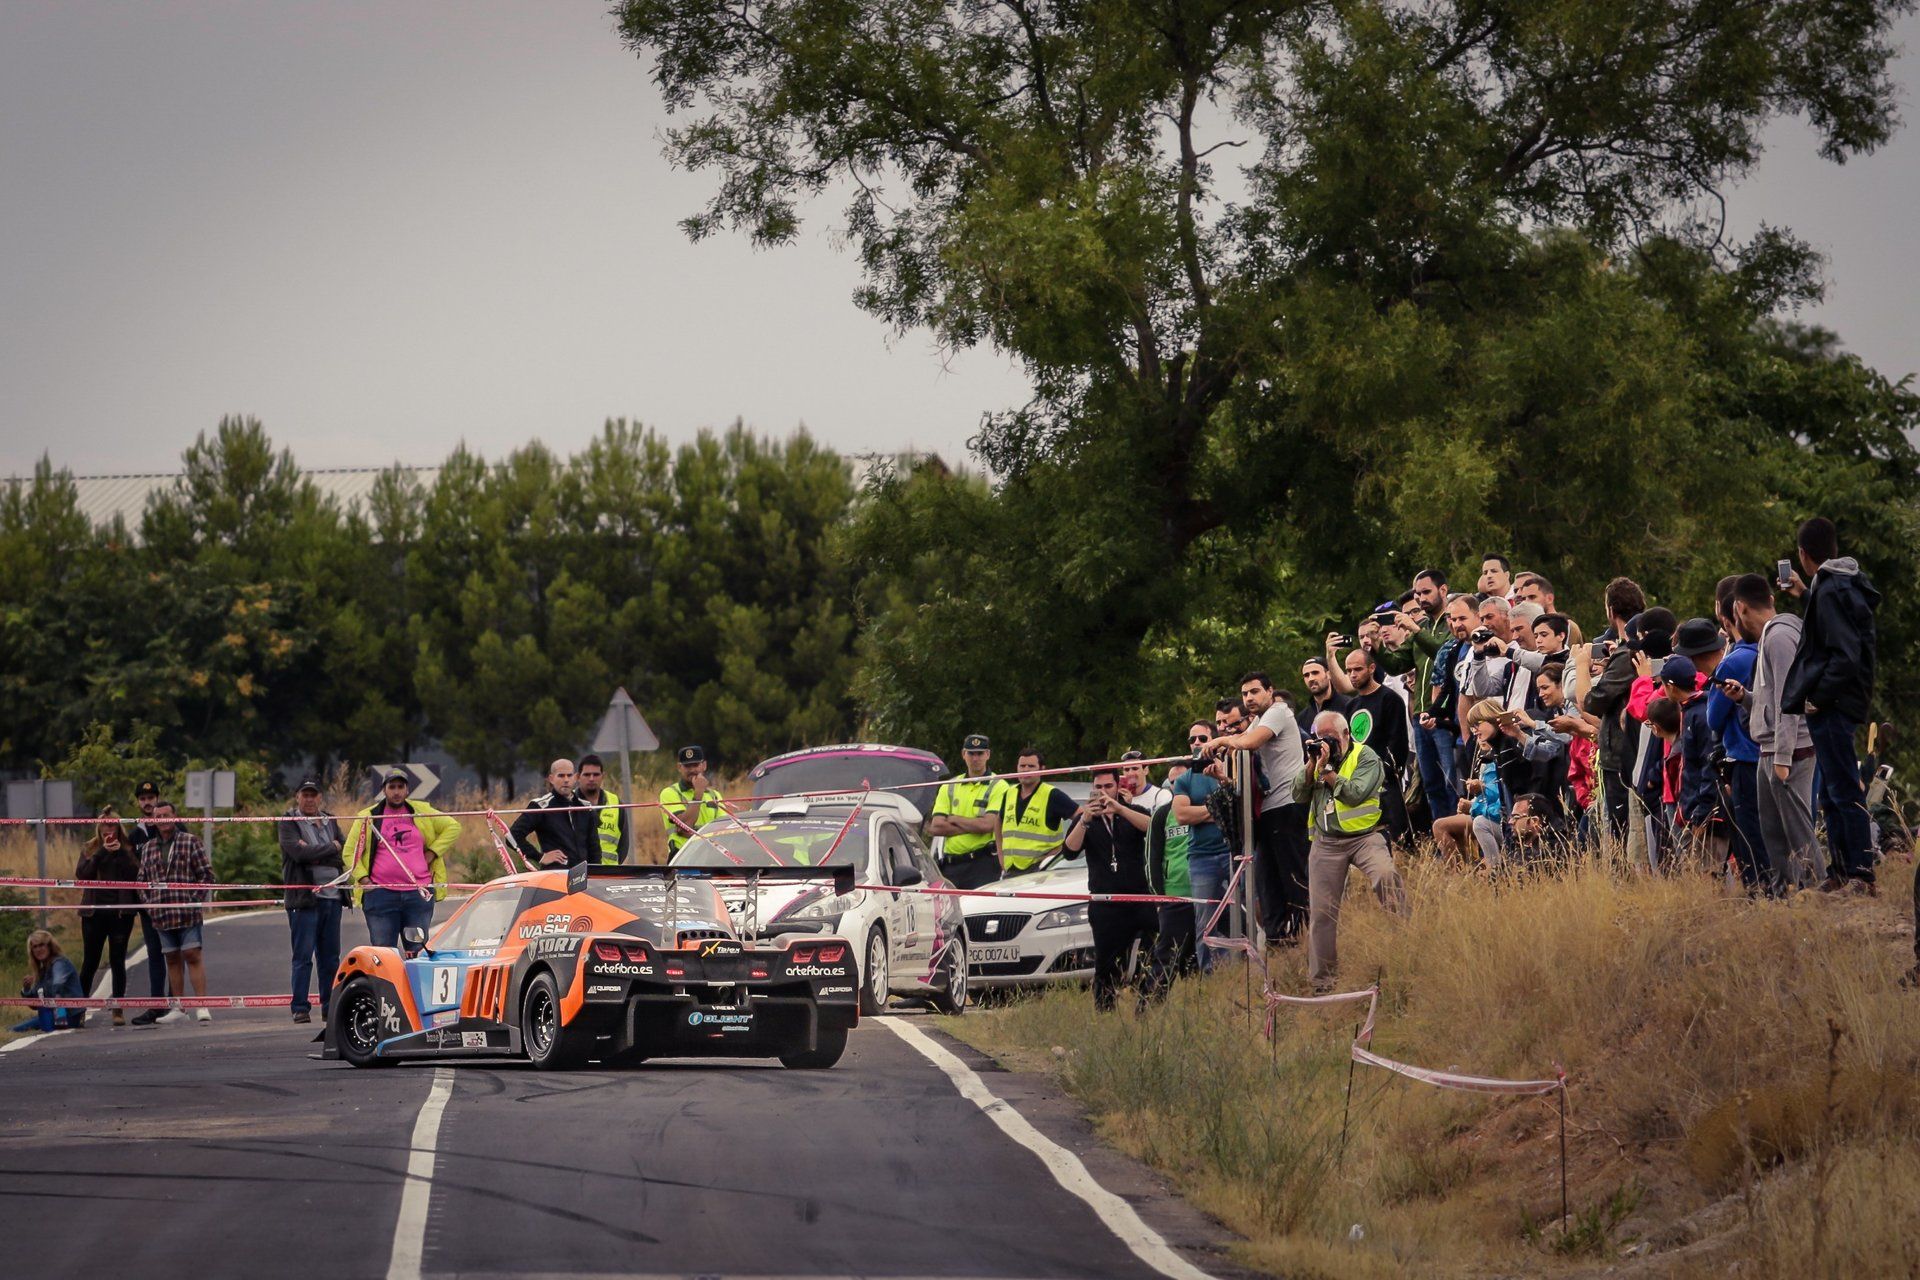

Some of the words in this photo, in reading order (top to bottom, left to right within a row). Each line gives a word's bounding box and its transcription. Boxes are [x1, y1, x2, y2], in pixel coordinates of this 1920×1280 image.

[546, 914, 571, 923] CAR
[519, 924, 568, 939] WASH
[985, 949, 1009, 961] 0074
[593, 962, 653, 975] artefibra.es
[785, 965, 845, 976] artefibra.es
[439, 968, 449, 1003] 3
